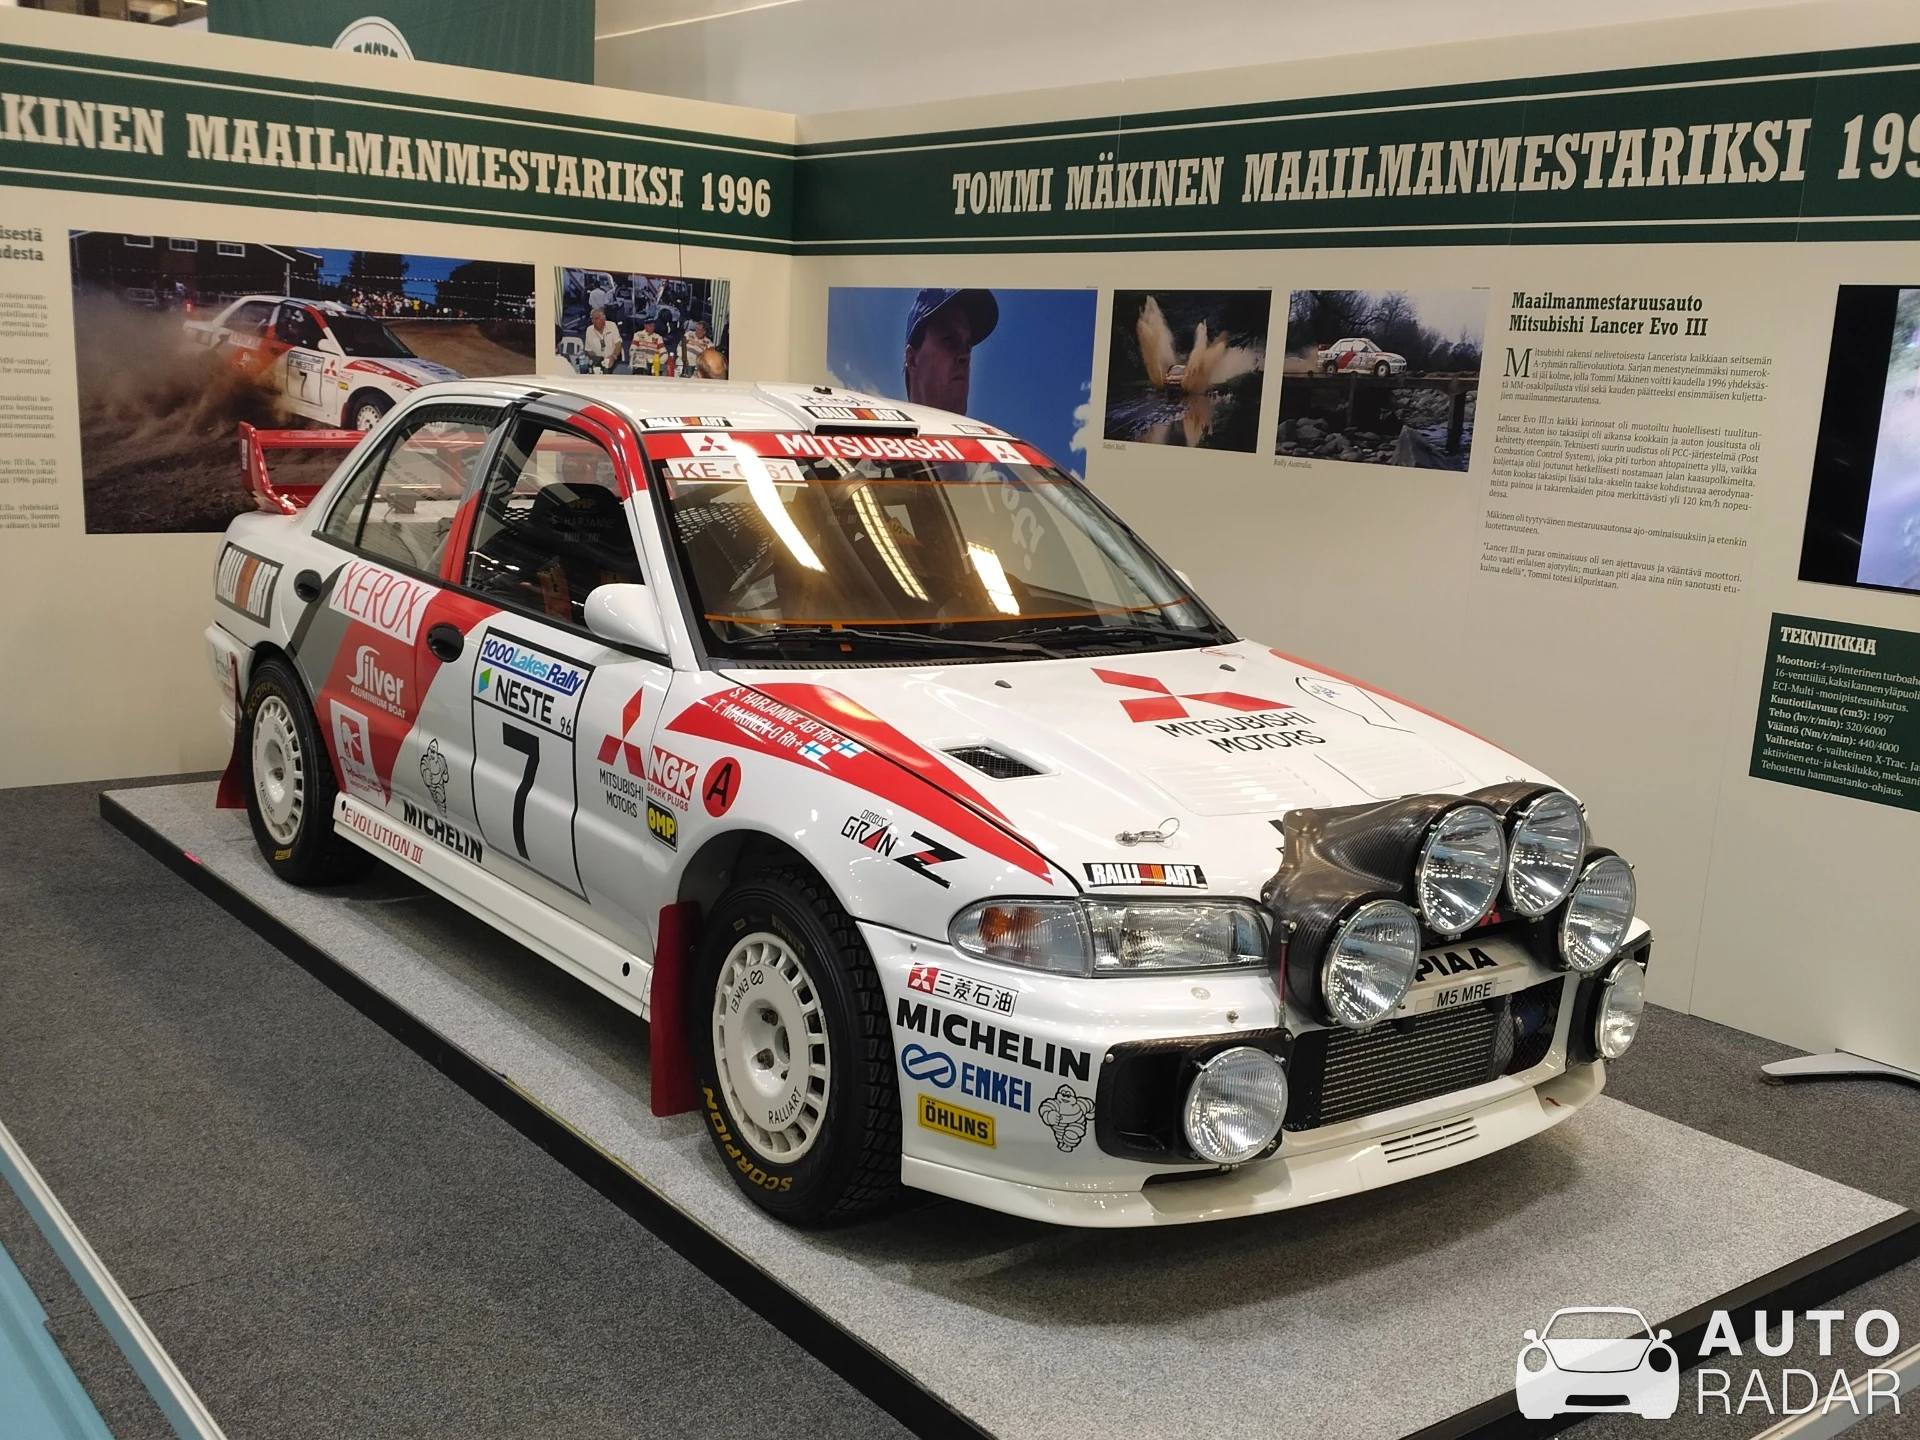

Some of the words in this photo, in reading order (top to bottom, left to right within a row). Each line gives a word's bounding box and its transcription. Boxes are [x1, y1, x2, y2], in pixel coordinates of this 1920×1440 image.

[0, 92, 164, 156] KINEN
[187, 112, 684, 208] MAAILMANMESTARIKSI
[701, 172, 771, 218] 1996
[953, 168, 1054, 215] TOMMI
[1065, 152, 1224, 211] MÄKINEN
[1242, 118, 1812, 202] MAAILMANMESTARIKSI
[1511, 291, 1703, 312] Maailmanmestaruusauto
[1509, 315, 1585, 334] Mitsubishi
[1590, 316, 1644, 335] Lancer
[1650, 318, 1678, 336] Evo
[1685, 318, 1708, 337] III
[1532, 359, 1567, 370] A-ryhmän
[1627, 362, 1652, 374] Sarjan
[1730, 366, 1769, 376] numerok-
[1566, 349, 1592, 358] rakensi
[1647, 351, 1687, 362] Lancerista
[1689, 353, 1727, 363] kaikkiaan
[1729, 355, 1772, 365] seitsemän
[300, 372, 308, 397] 7
[1500, 390, 1514, 400] jien
[1548, 370, 1572, 382] kolme,
[1572, 371, 1589, 383] jolla
[1590, 372, 1616, 382] Tommi
[1616, 373, 1649, 384] Mäkinen
[1649, 375, 1671, 385] voitti
[1672, 376, 1706, 386] kaudella
[1707, 377, 1727, 387] 1996
[1727, 378, 1768, 391] yhdeksäs-
[1574, 382, 1590, 392] viisi
[1590, 383, 1607, 393] sekä
[1608, 384, 1636, 395] kauden
[1636, 386, 1676, 397] päätteeksi
[1677, 388, 1730, 399] ensimmäisen
[1731, 390, 1766, 402] kuljetta-
[700, 417, 727, 427] ART
[808, 406, 859, 420] RALLI
[875, 408, 906, 421] ART
[775, 434, 965, 460] MITSUBISHI
[246, 558, 278, 618] ART
[332, 561, 434, 646] XEROX
[1781, 626, 1877, 655] TEKNIIKKAA
[346, 645, 404, 706] Silver
[483, 639, 514, 663] 1000
[510, 648, 549, 678] Lakes
[546, 663, 584, 691] Rally
[1775, 668, 1827, 685] 16-venttiiliä,
[1828, 676, 1850, 688] kaksi
[1851, 679, 1883, 693] kannen
[1776, 654, 1819, 669] Moottori:
[1820, 662, 1881, 679] 4-sylinterinen
[350, 685, 388, 710] ALUMINIUM
[388, 702, 406, 719] BOAT
[495, 674, 555, 725] NESTE
[1770, 694, 1837, 713] Kuutiotilavuus
[1839, 706, 1870, 720] (cm3):
[1872, 712, 1894, 723] 1997
[1772, 680, 1814, 695] ECI-Multi
[1816, 690, 1907, 711] -monipistesuihkutus.
[560, 716, 572, 735] 96
[712, 699, 727, 713] T.
[777, 731, 803, 748] Rh+
[729, 687, 747, 699] S.
[740, 691, 804, 725] HARJANNE
[794, 717, 820, 734] AB
[812, 726, 841, 744] Rh+
[1157, 711, 1316, 738] MITSUBISHI
[1769, 707, 1791, 719] Teho
[1793, 712, 1843, 729] (hv/r/min):
[1845, 721, 1886, 736] 320/6000
[1207, 729, 1326, 753] MOTORS
[1765, 734, 1813, 750] Vaihteisto:
[1816, 744, 1872, 762] 6-vaihteinen
[1874, 754, 1907, 769] X-Trac.
[1767, 720, 1799, 734] Vääntö
[1800, 727, 1856, 746] (Nm/r/min):
[1857, 738, 1899, 753] 440/4000
[648, 749, 696, 801] NGK
[1761, 759, 1805, 776] Tehostettu
[1807, 769, 1902, 796] hammastanko-ohjaus.
[1762, 747, 1804, 762] aktiivinen
[1804, 756, 1822, 765] etu-
[1823, 758, 1831, 768] ja
[1832, 760, 1880, 779] keskilukko,
[502, 722, 541, 862] 7
[599, 768, 645, 802] MITSUBISHI
[647, 783, 666, 801] SPARK
[666, 790, 689, 812] PLUGS
[706, 762, 733, 808] A
[606, 794, 638, 818] MOTORS
[860, 809, 888, 827] ORBIS
[344, 806, 411, 861] EVOLUTION
[411, 845, 424, 865] III
[403, 803, 483, 864] MICHELIN
[647, 806, 677, 842] OMP
[1091, 864, 1141, 886] RALLI
[1163, 864, 1201, 886] ART
[1414, 947, 1498, 982] PIAA
[731, 975, 749, 1014] ENKEI
[935, 972, 1014, 1012] 三菱石油
[1437, 989, 1458, 1007] M5
[1461, 982, 1493, 1003] MRE
[897, 997, 1091, 1082] MICHELIN
[960, 1061, 1031, 1113] ENKEI
[768, 1085, 802, 1125] RALLIART
[924, 1100, 990, 1140] ÖHLINS
[701, 1085, 793, 1193] SCORPION
